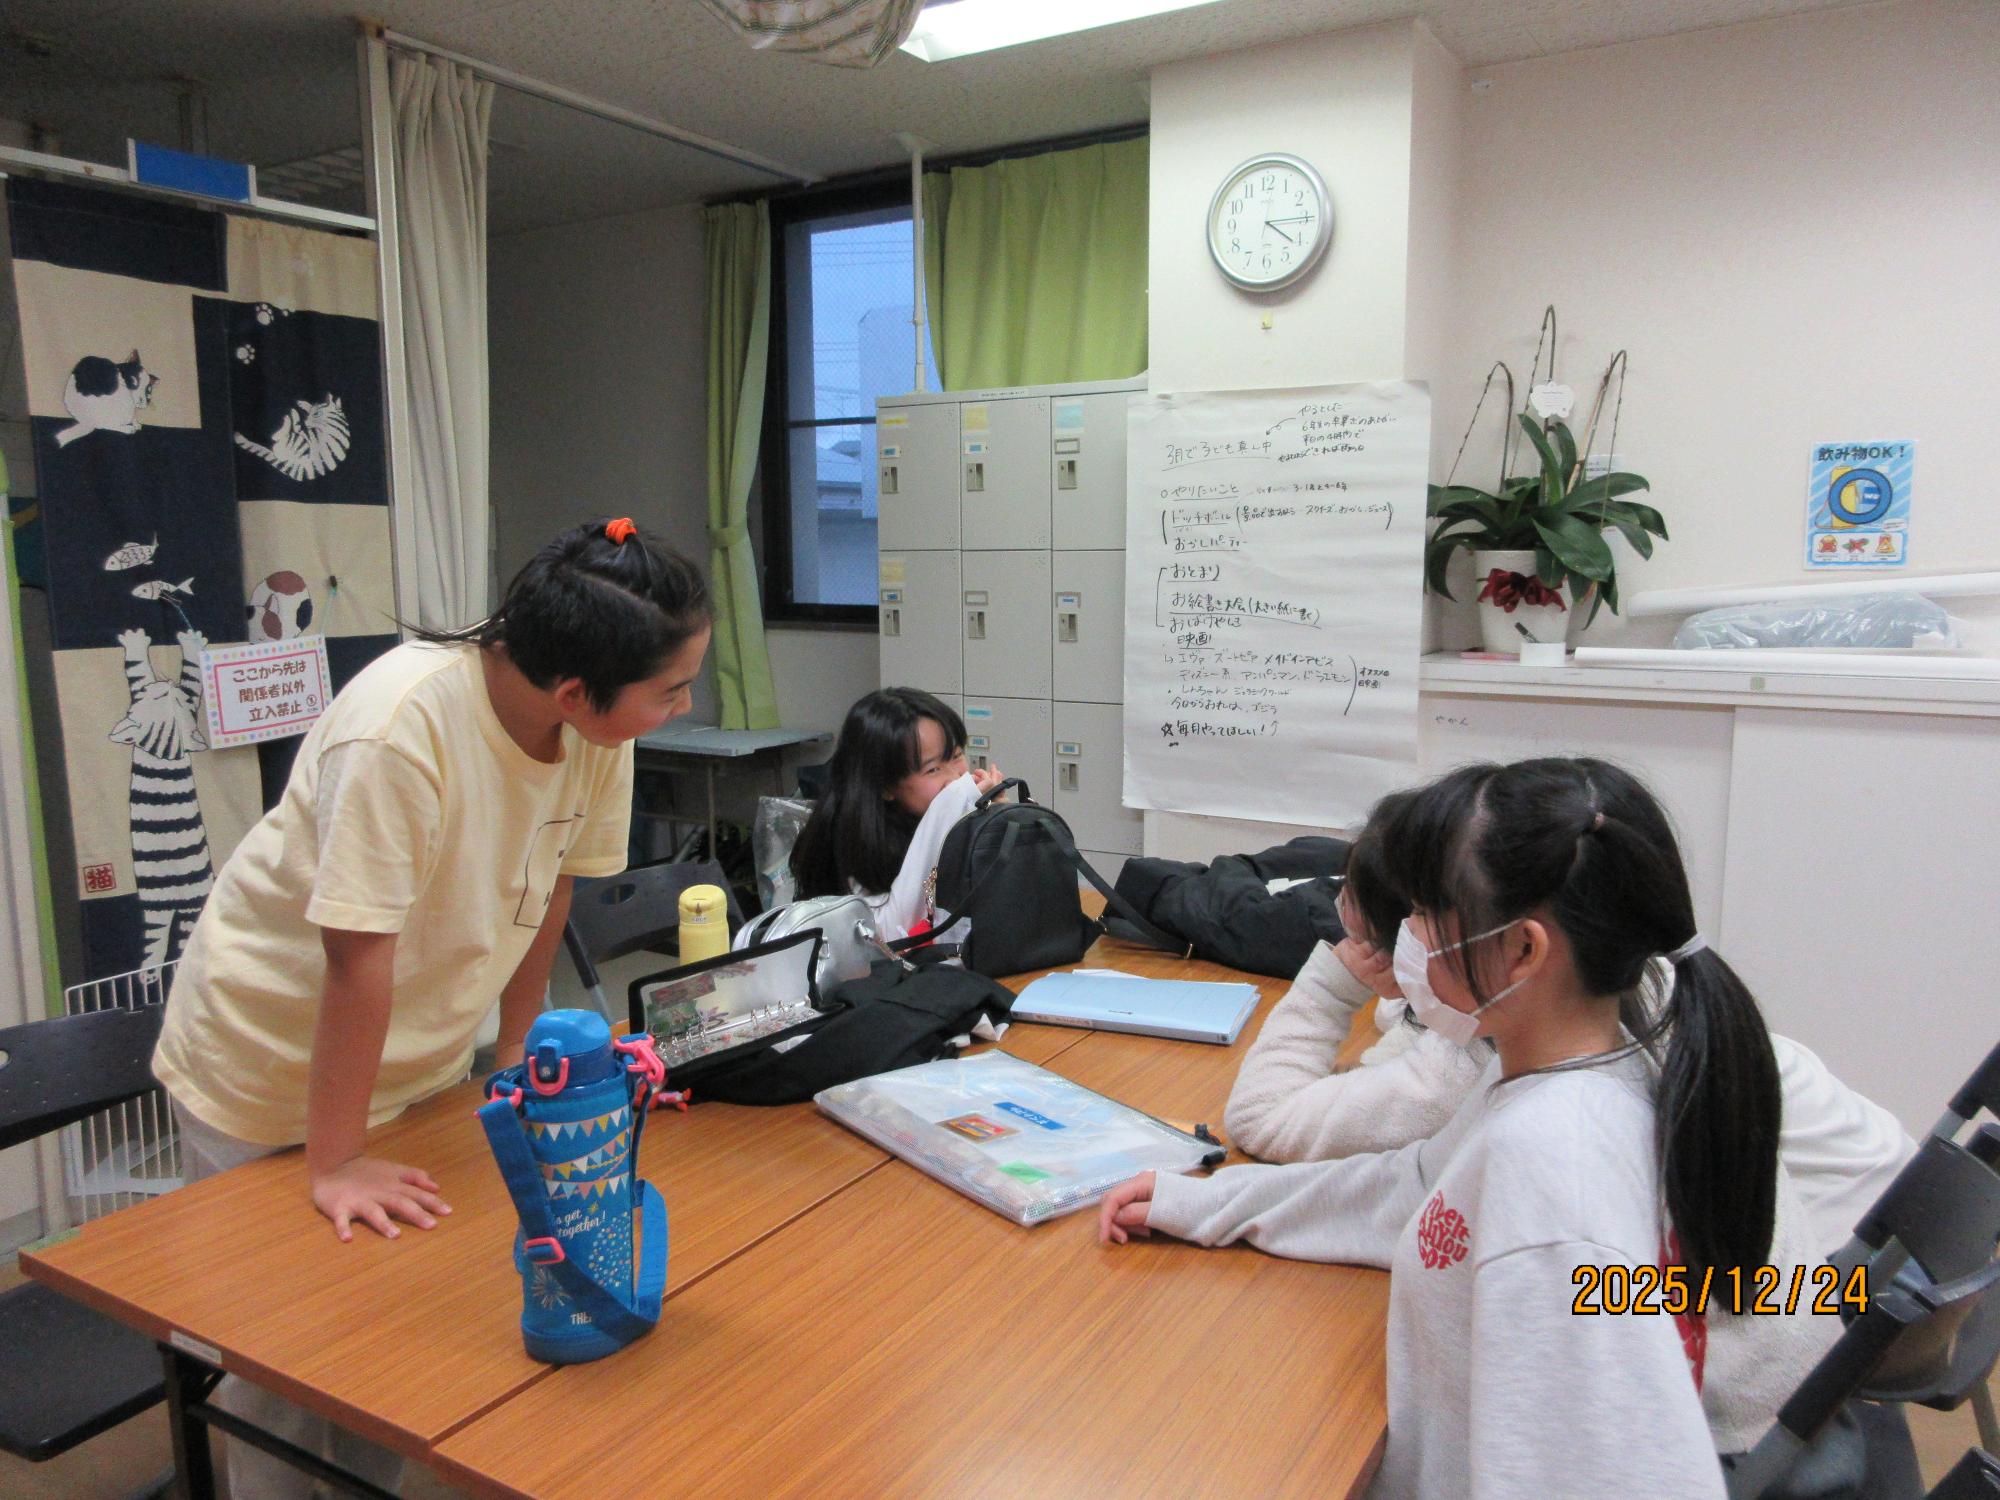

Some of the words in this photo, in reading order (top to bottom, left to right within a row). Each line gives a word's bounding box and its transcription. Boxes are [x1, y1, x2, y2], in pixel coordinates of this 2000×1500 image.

[1261, 174, 1275, 191] 12
[1283, 178, 1289, 193] 1
[1244, 183, 1254, 199] 11
[1294, 191, 1304, 207] 2
[1231, 198, 1244, 215] 10
[1299, 209, 1309, 225] 3
[1227, 218, 1237, 234] 9
[1231, 237, 1241, 253] 8
[1292, 231, 1302, 246] 4
[1244, 250, 1253, 267] 7
[1262, 254, 1272, 270] 6
[1280, 246, 1290, 262] 5
[1818, 445, 1905, 461] 飲み物OK!
[1171, 562, 1221, 582] おとまり
[1177, 631, 1213, 648] 映画
[232, 660, 307, 683] ここから先は
[239, 679, 305, 704] 関係者以外
[248, 700, 304, 722] 立入禁止
